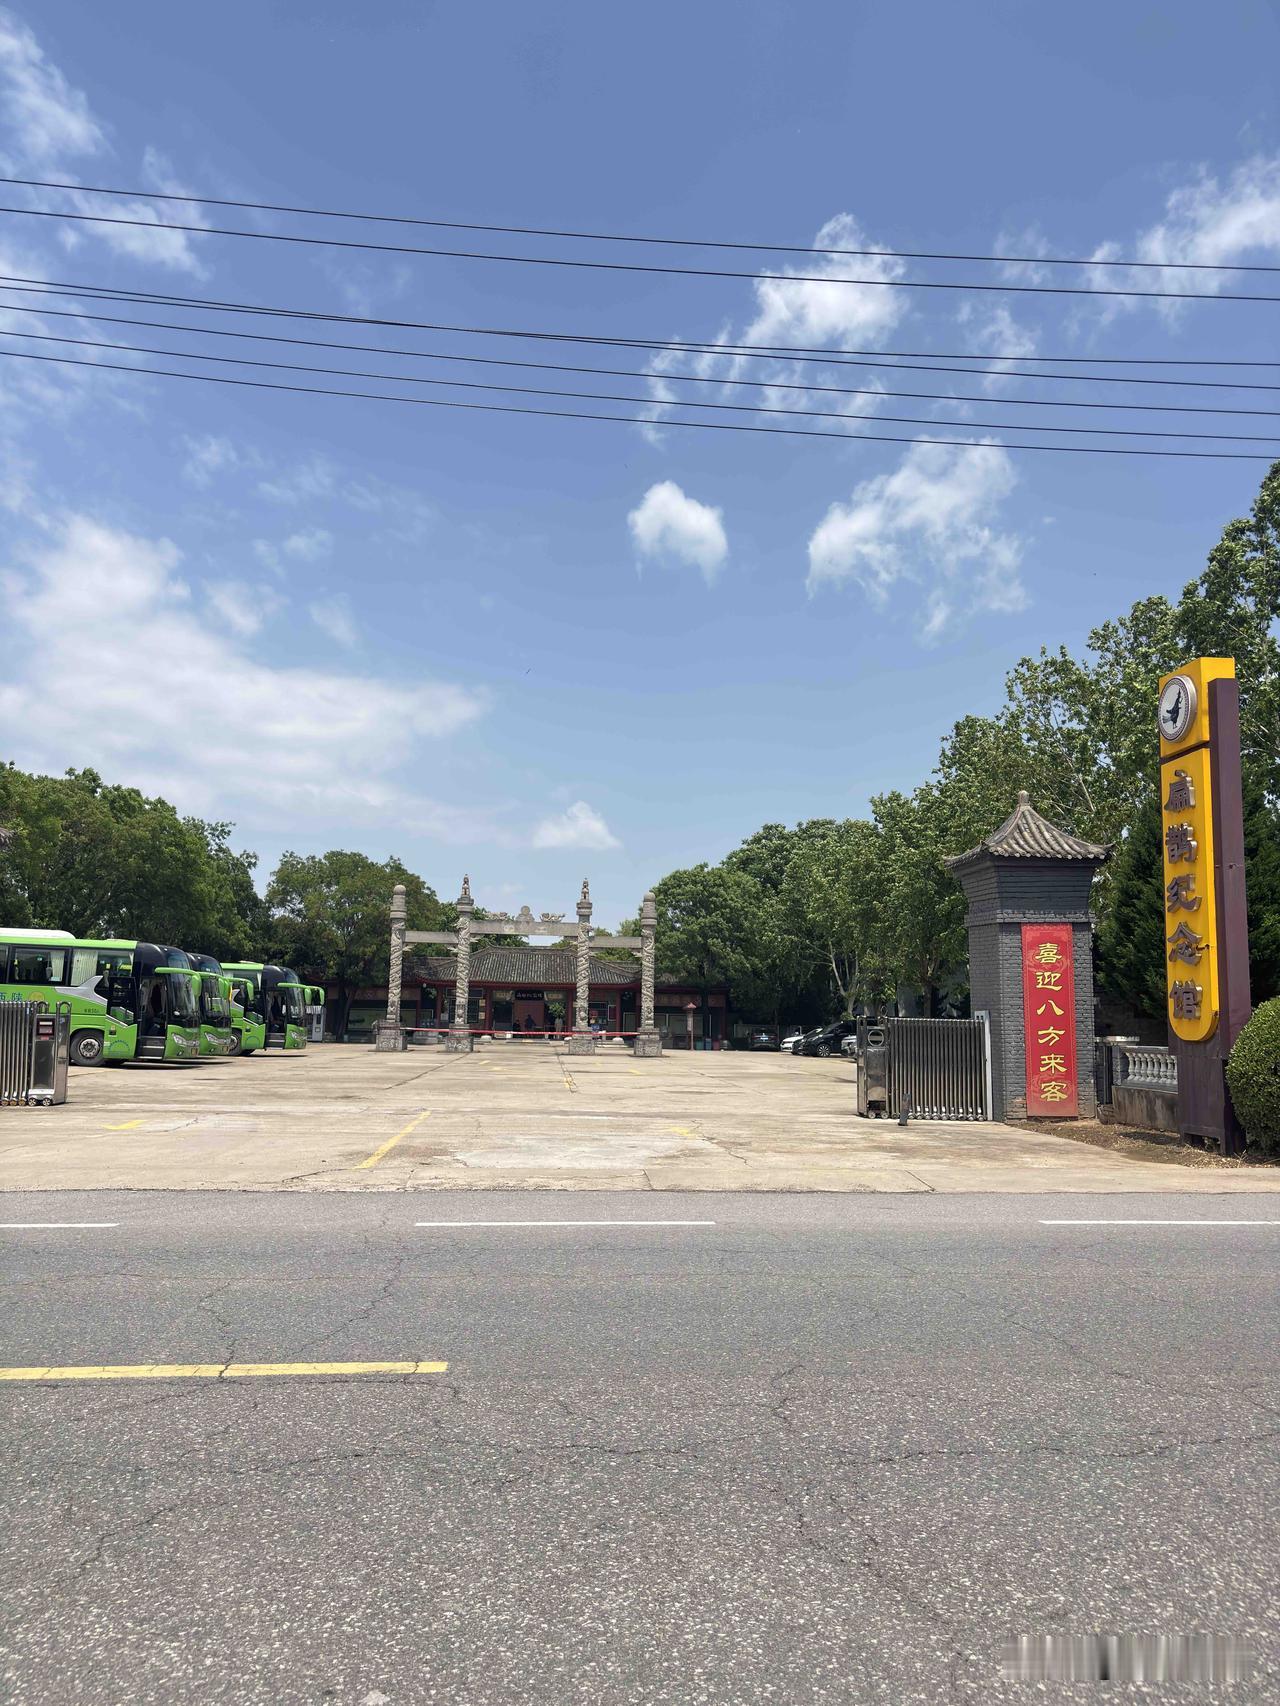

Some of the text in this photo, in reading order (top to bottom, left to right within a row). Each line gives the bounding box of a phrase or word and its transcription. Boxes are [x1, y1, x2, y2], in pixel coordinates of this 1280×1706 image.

[1164, 769, 1202, 1021] 扁鹊纪念馆
[1035, 942, 1068, 1102] 喜迎八方来客
